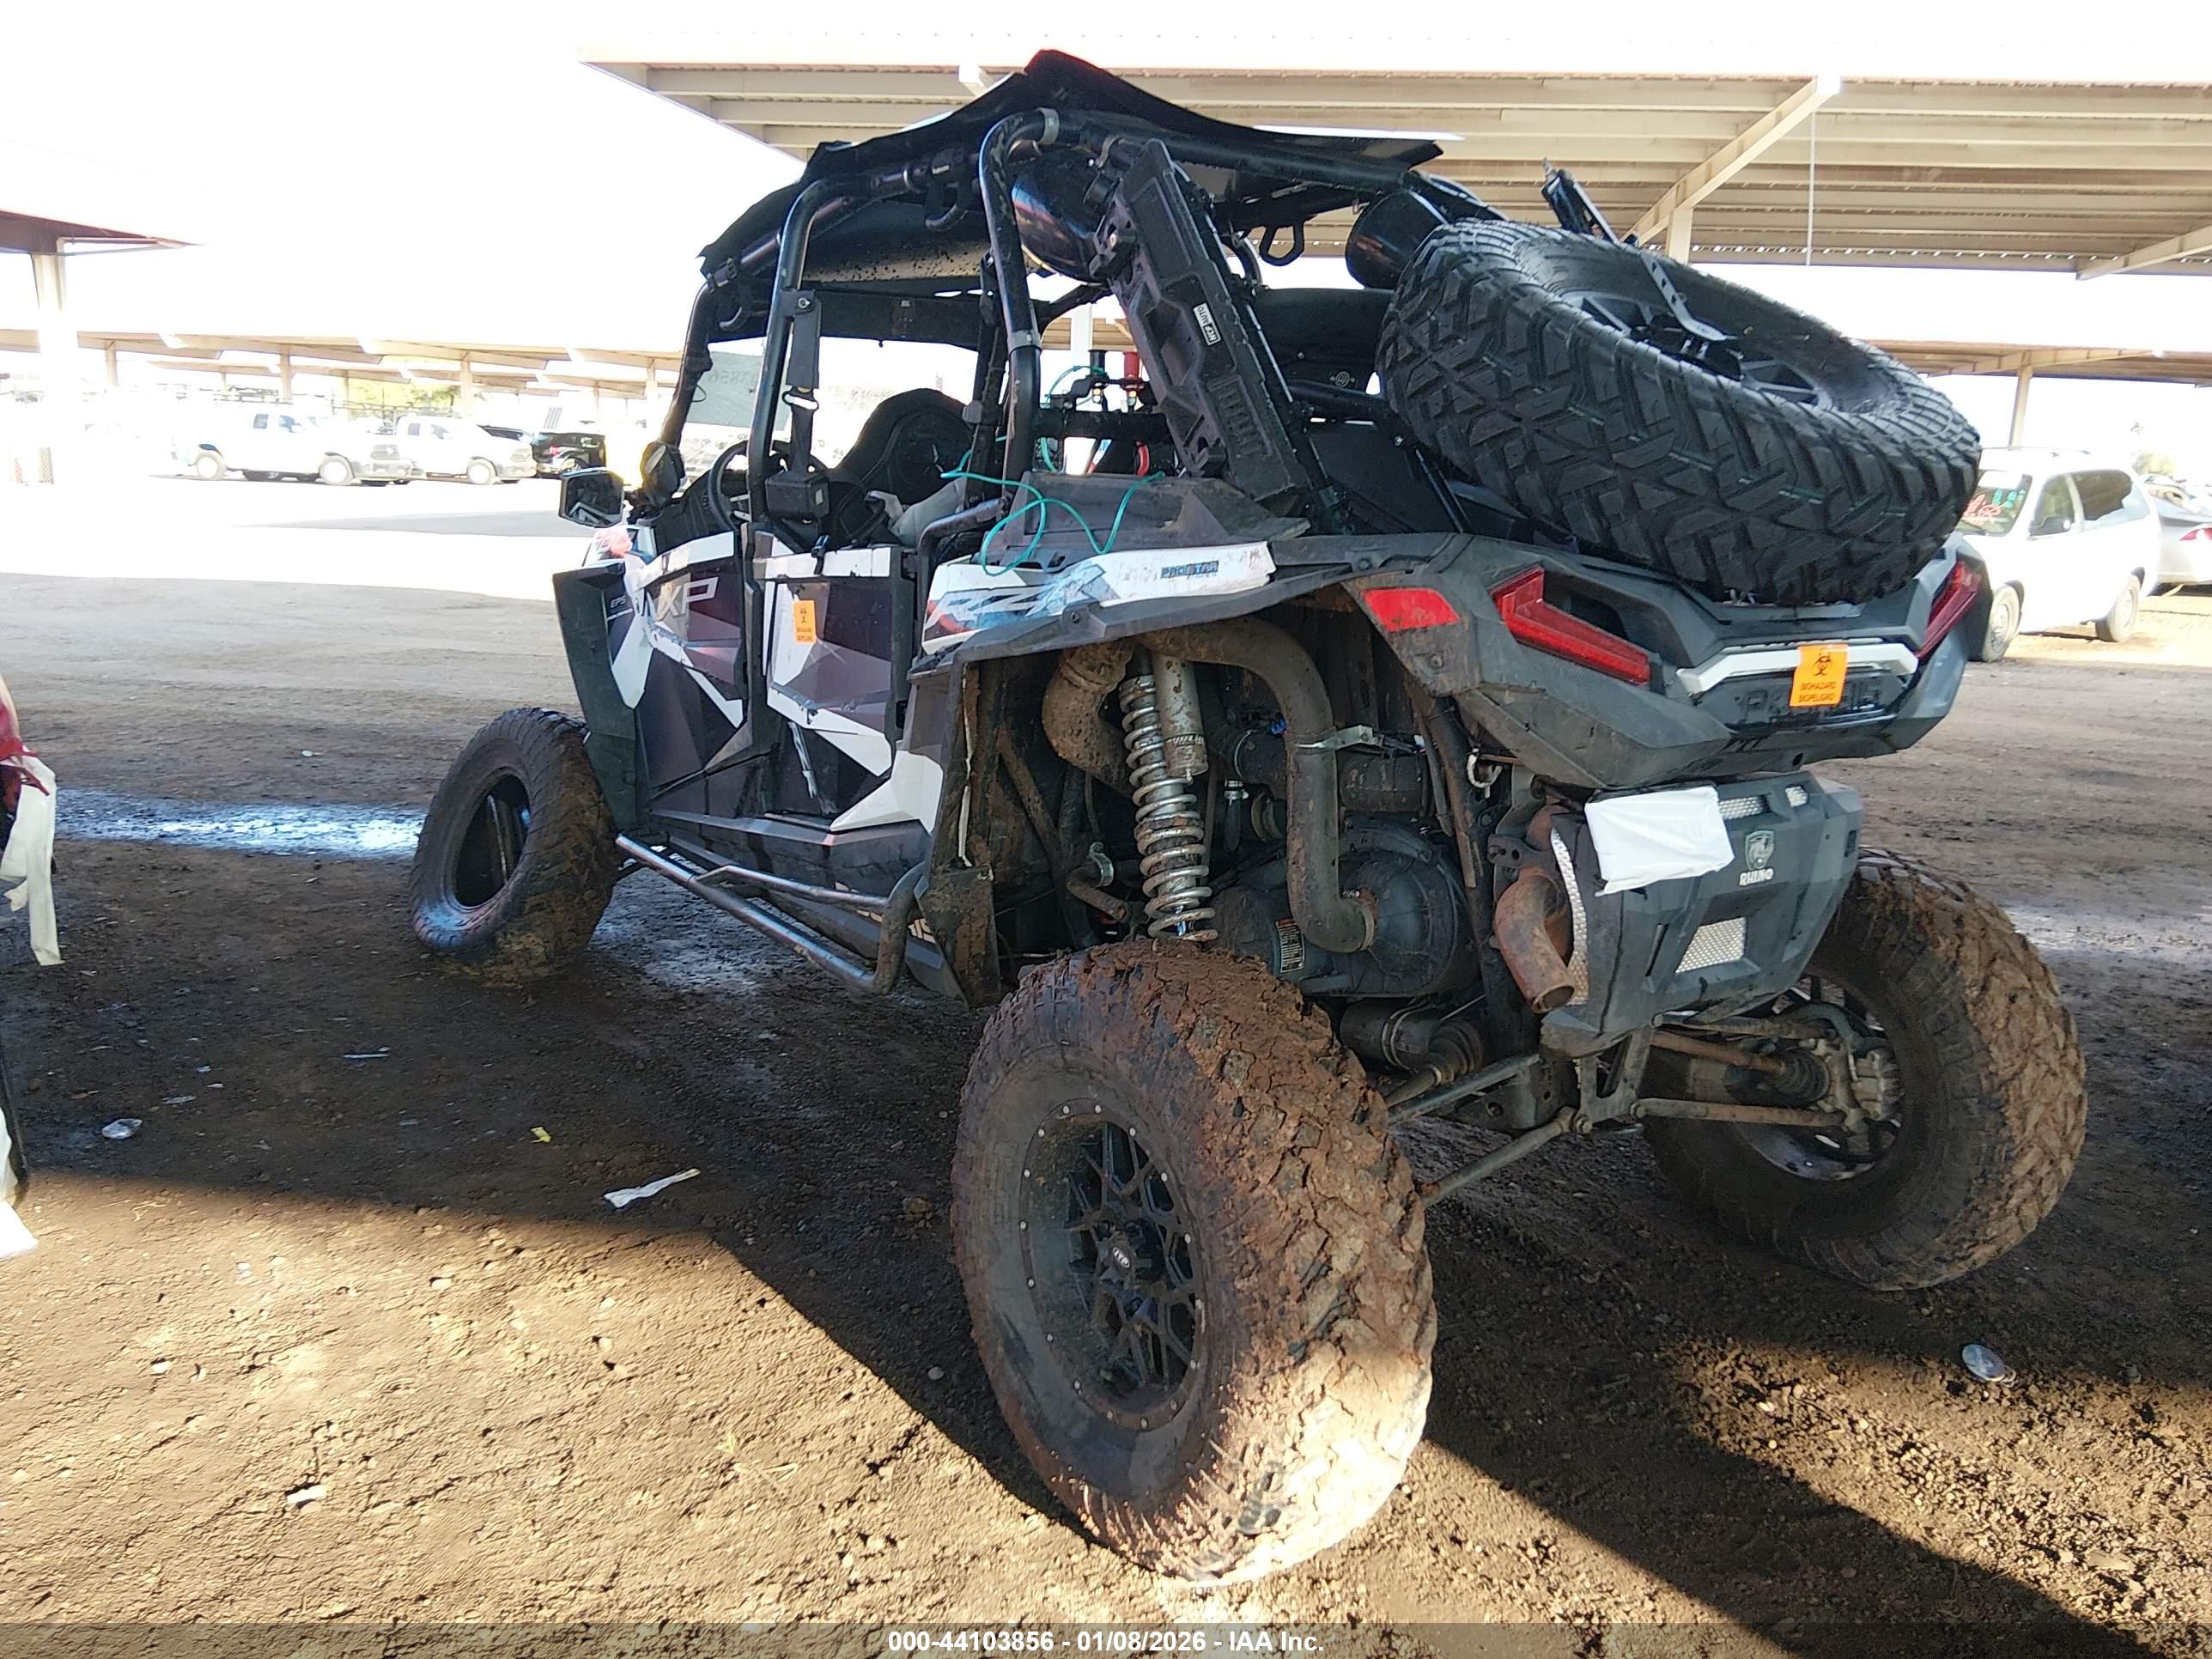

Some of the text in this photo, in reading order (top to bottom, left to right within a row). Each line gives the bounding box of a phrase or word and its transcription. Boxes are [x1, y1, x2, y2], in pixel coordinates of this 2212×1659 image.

[1160, 561, 1218, 579] PROSTAR
[655, 577, 719, 622] XP
[1739, 867, 1774, 886] RHINO
